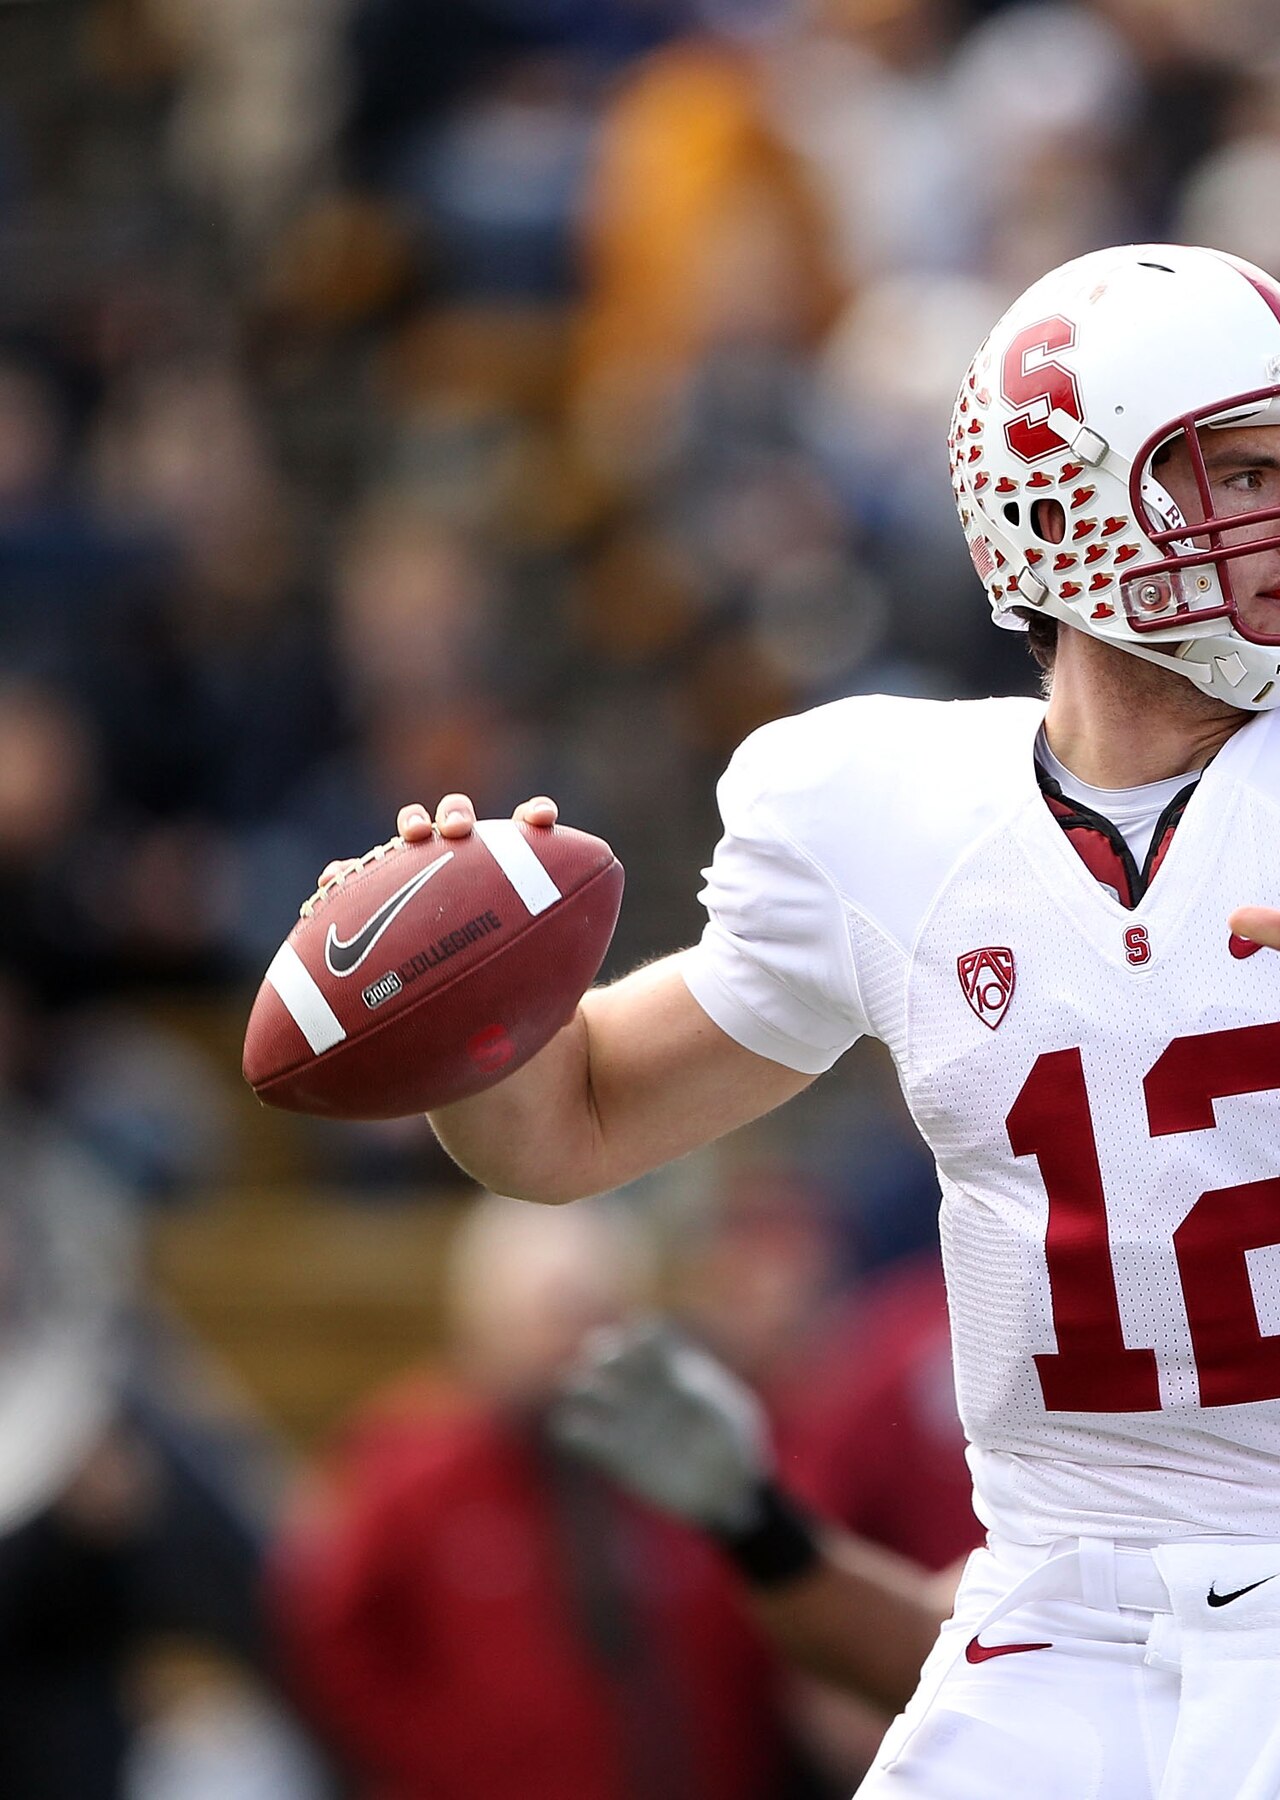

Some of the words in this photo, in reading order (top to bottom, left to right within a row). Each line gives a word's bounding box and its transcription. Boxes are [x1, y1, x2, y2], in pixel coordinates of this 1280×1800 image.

[1001, 314, 1084, 464] S
[400, 910, 502, 983] COLLEGIATE
[1122, 924, 1152, 966] S
[960, 950, 1011, 998] PAC
[976, 982, 1007, 1013] 10
